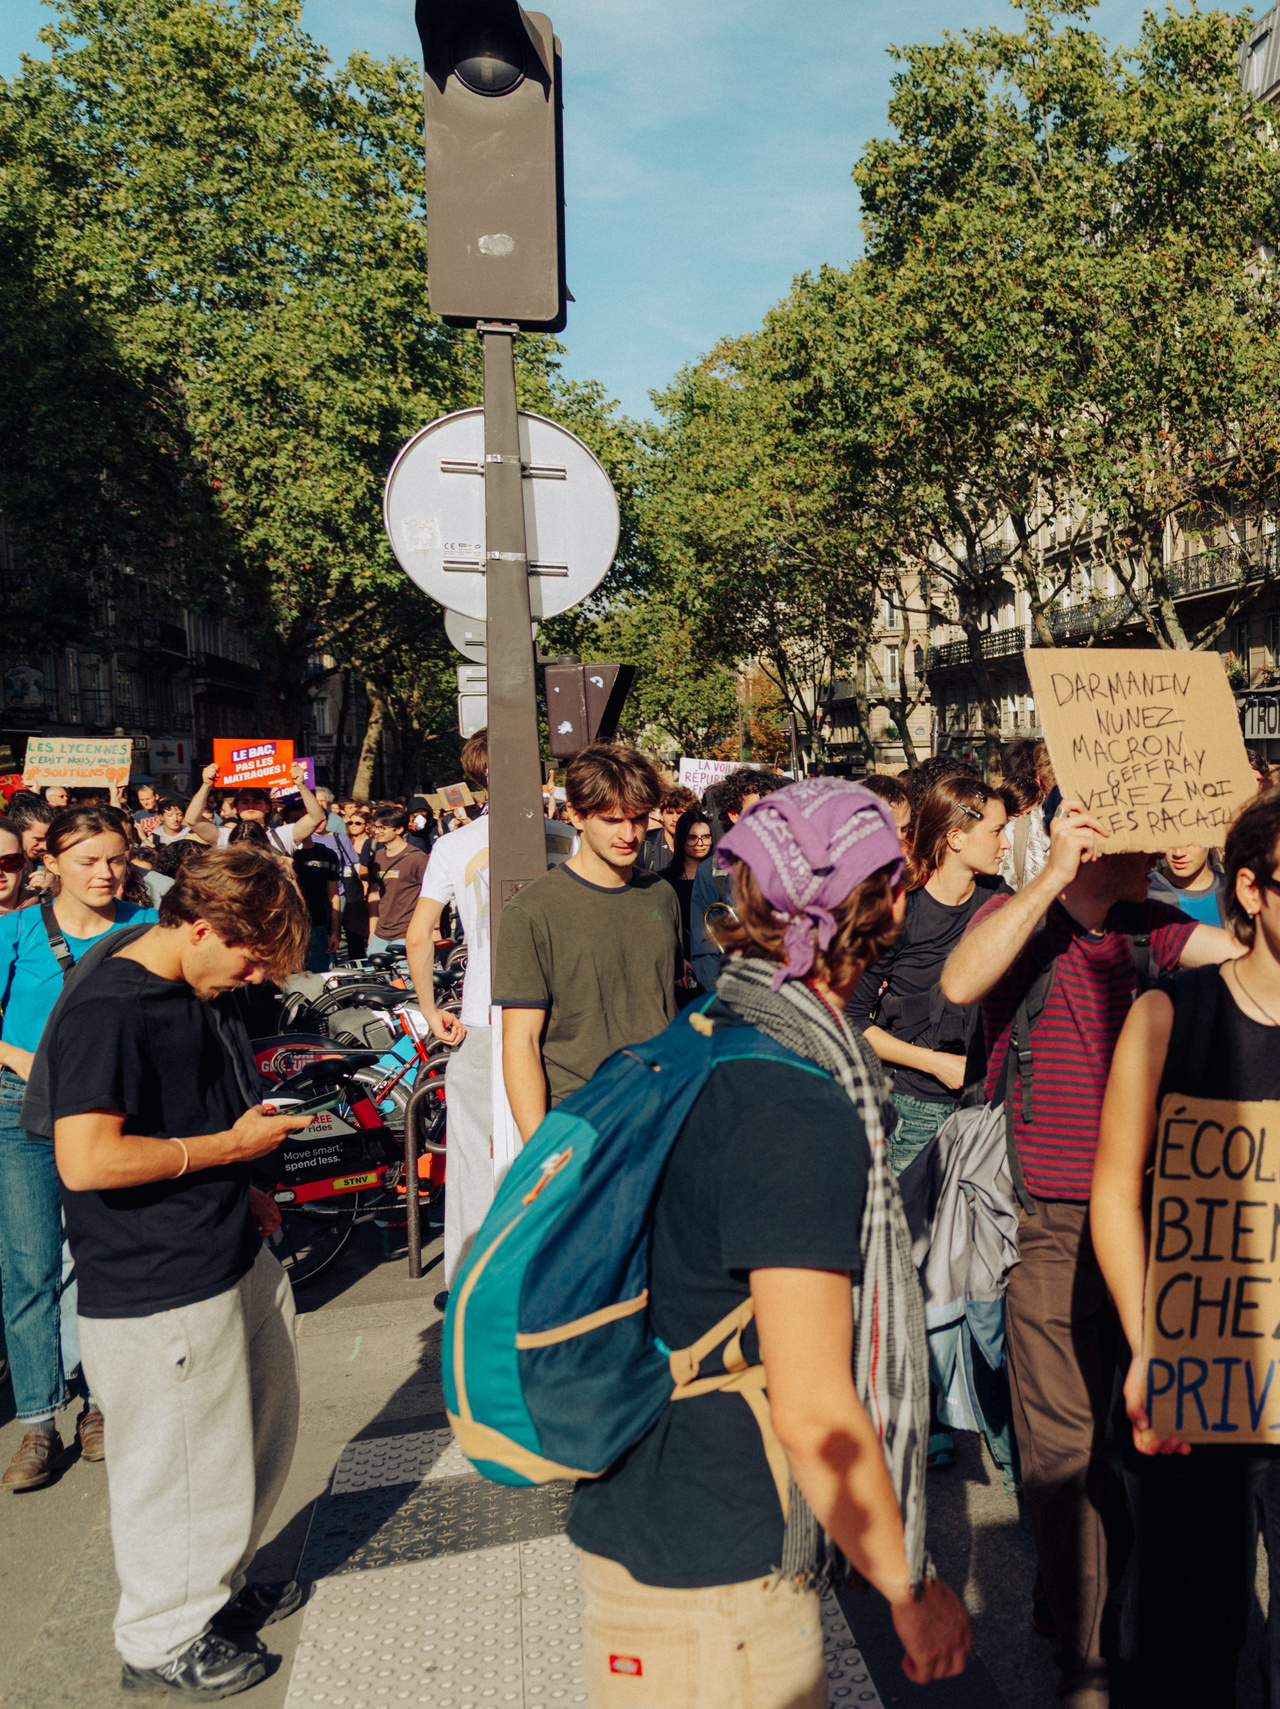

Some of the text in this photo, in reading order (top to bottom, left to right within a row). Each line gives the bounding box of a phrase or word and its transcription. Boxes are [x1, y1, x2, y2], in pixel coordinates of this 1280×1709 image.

[1051, 671, 1191, 706] DARMANIN
[1097, 706, 1185, 736] NUNEZ
[28, 742, 54, 753] LES
[233, 744, 275, 762] LE BAC,
[1073, 731, 1183, 767] MACRON
[235, 757, 274, 772] PAS LES
[698, 760, 710, 770] LA
[1107, 749, 1206, 787] GEFFRAY
[223, 765, 281, 785] MATRAQUES
[1076, 780, 1233, 811] VIREZ MOI
[1097, 810, 1139, 834] ES
[313, 1114, 332, 1125] REE
[309, 1124, 332, 1133] rides
[283, 1150, 310, 1161] Move
[285, 1155, 341, 1171] spend less.
[343, 1176, 368, 1186] STNV
